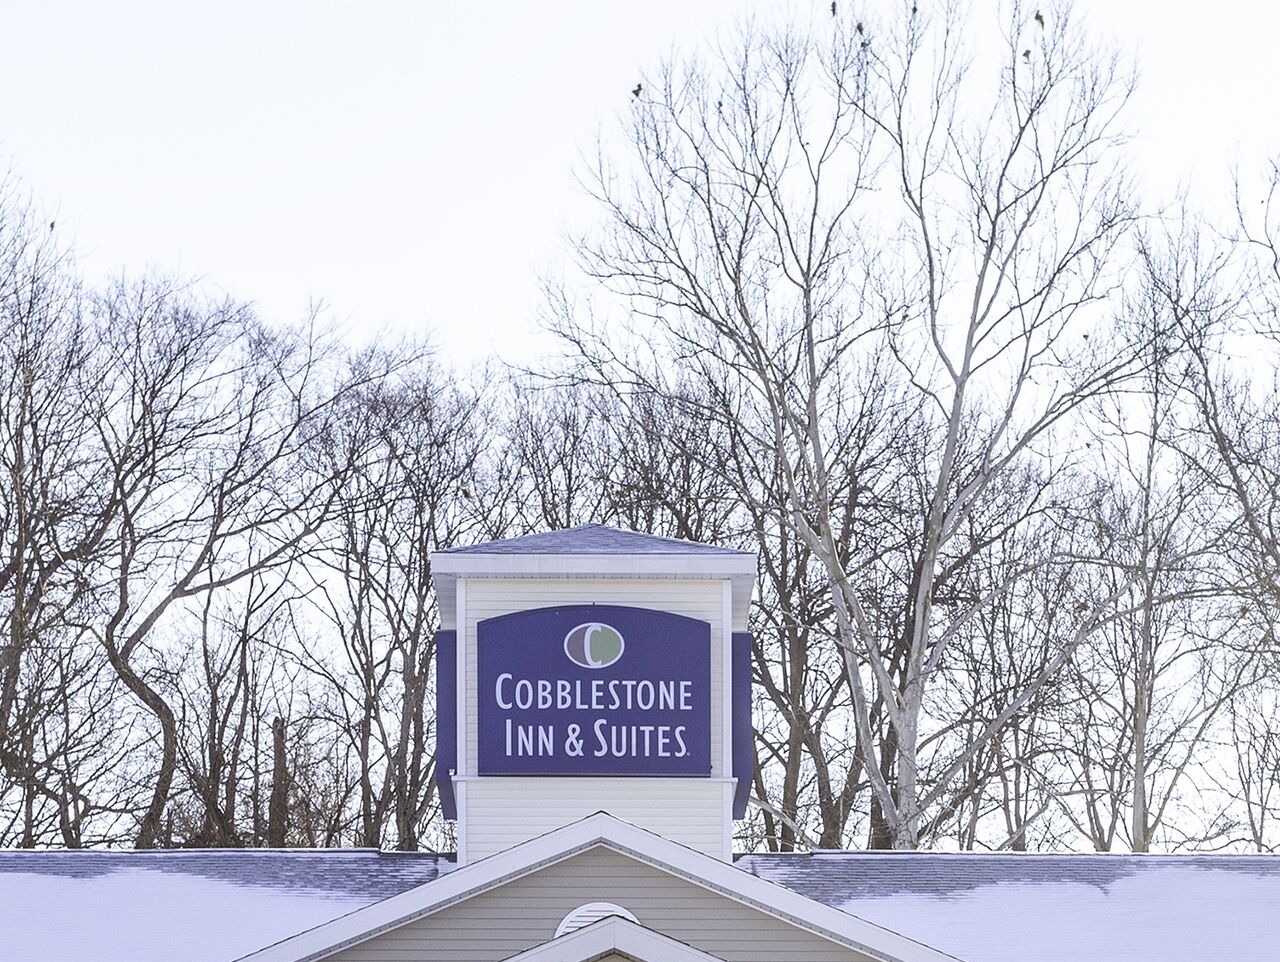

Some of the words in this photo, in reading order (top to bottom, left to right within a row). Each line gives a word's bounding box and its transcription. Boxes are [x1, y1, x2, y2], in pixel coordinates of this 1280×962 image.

[495, 673, 693, 710] COBBLESTONE
[505, 719, 554, 757] INN
[565, 723, 584, 757] &
[593, 719, 687, 758] SUITES
